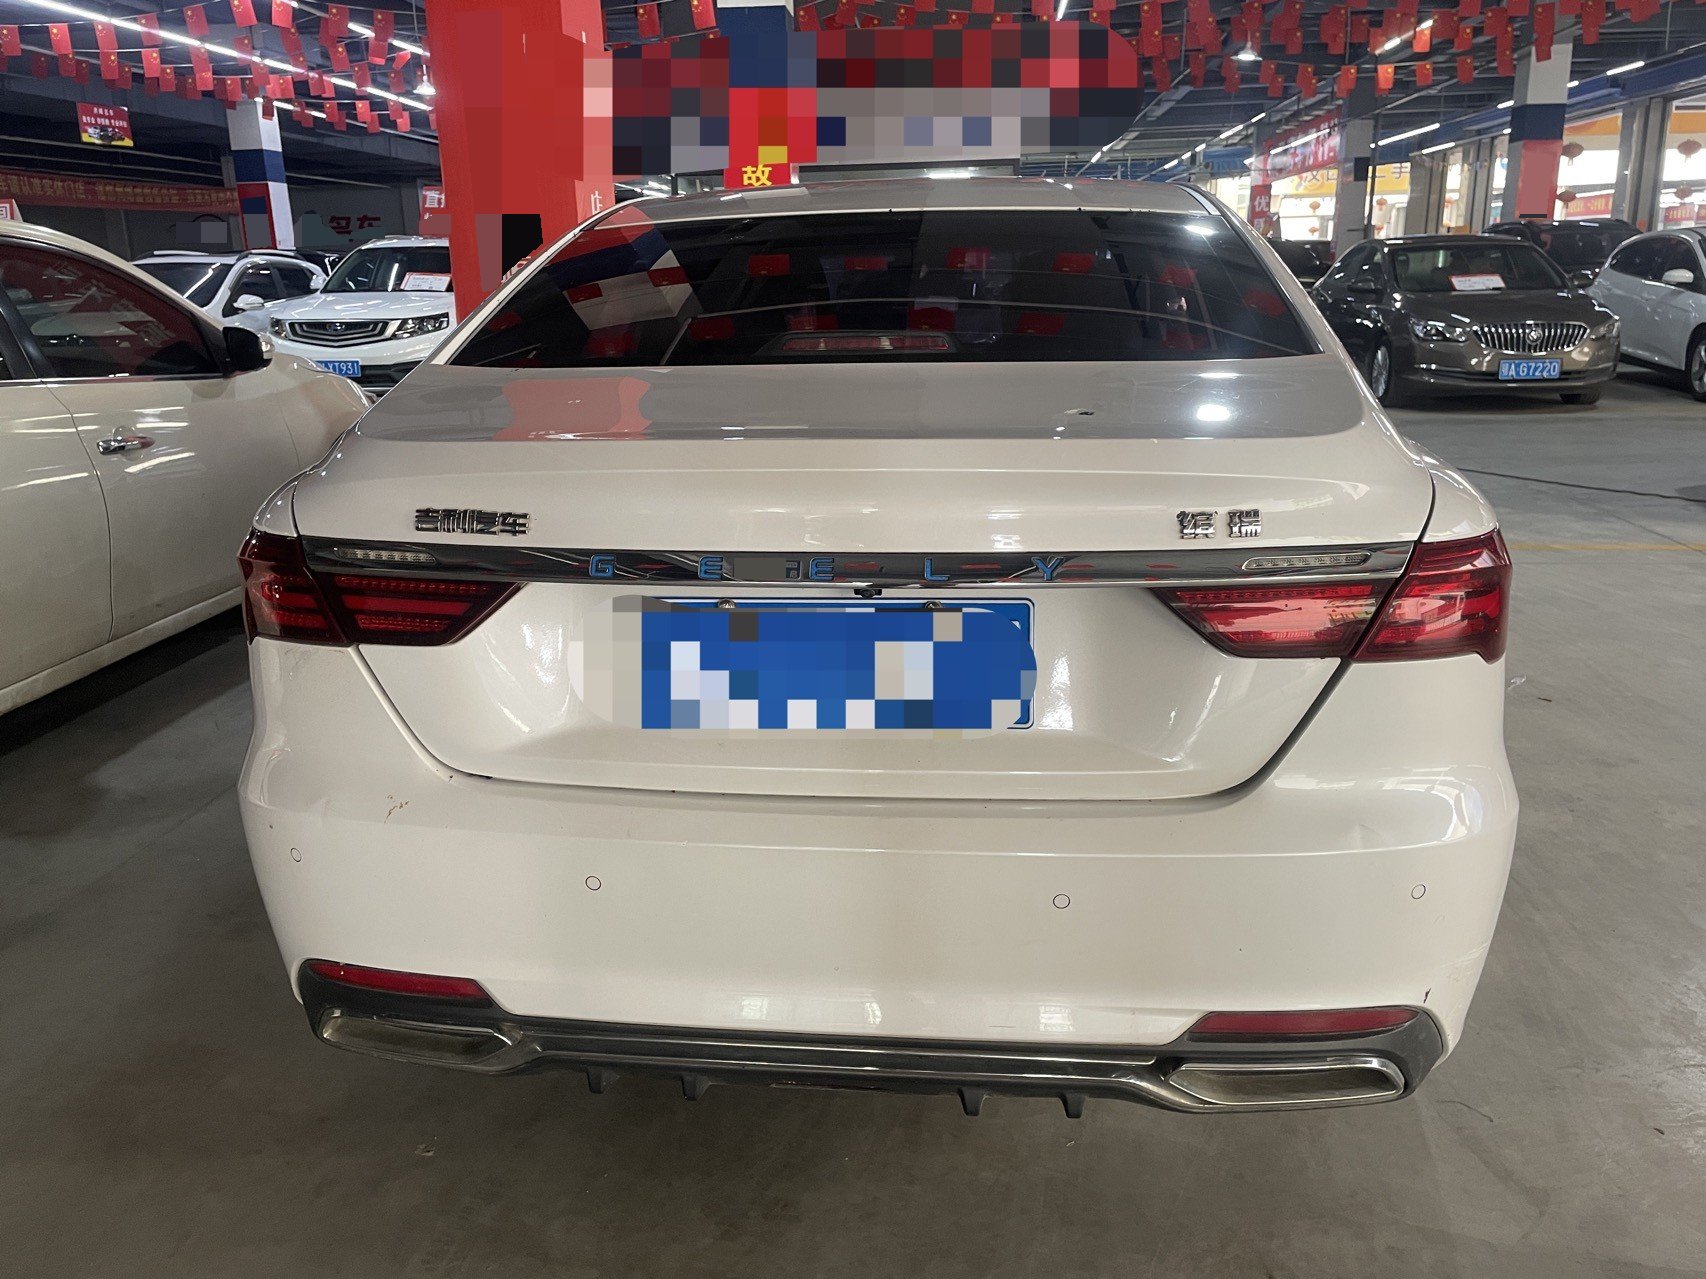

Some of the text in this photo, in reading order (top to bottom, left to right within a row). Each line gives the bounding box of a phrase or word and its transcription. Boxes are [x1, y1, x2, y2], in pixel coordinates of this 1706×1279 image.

[741, 164, 773, 187] 故
[321, 361, 358, 375] XT931
[415, 507, 531, 537] 吉利汽车
